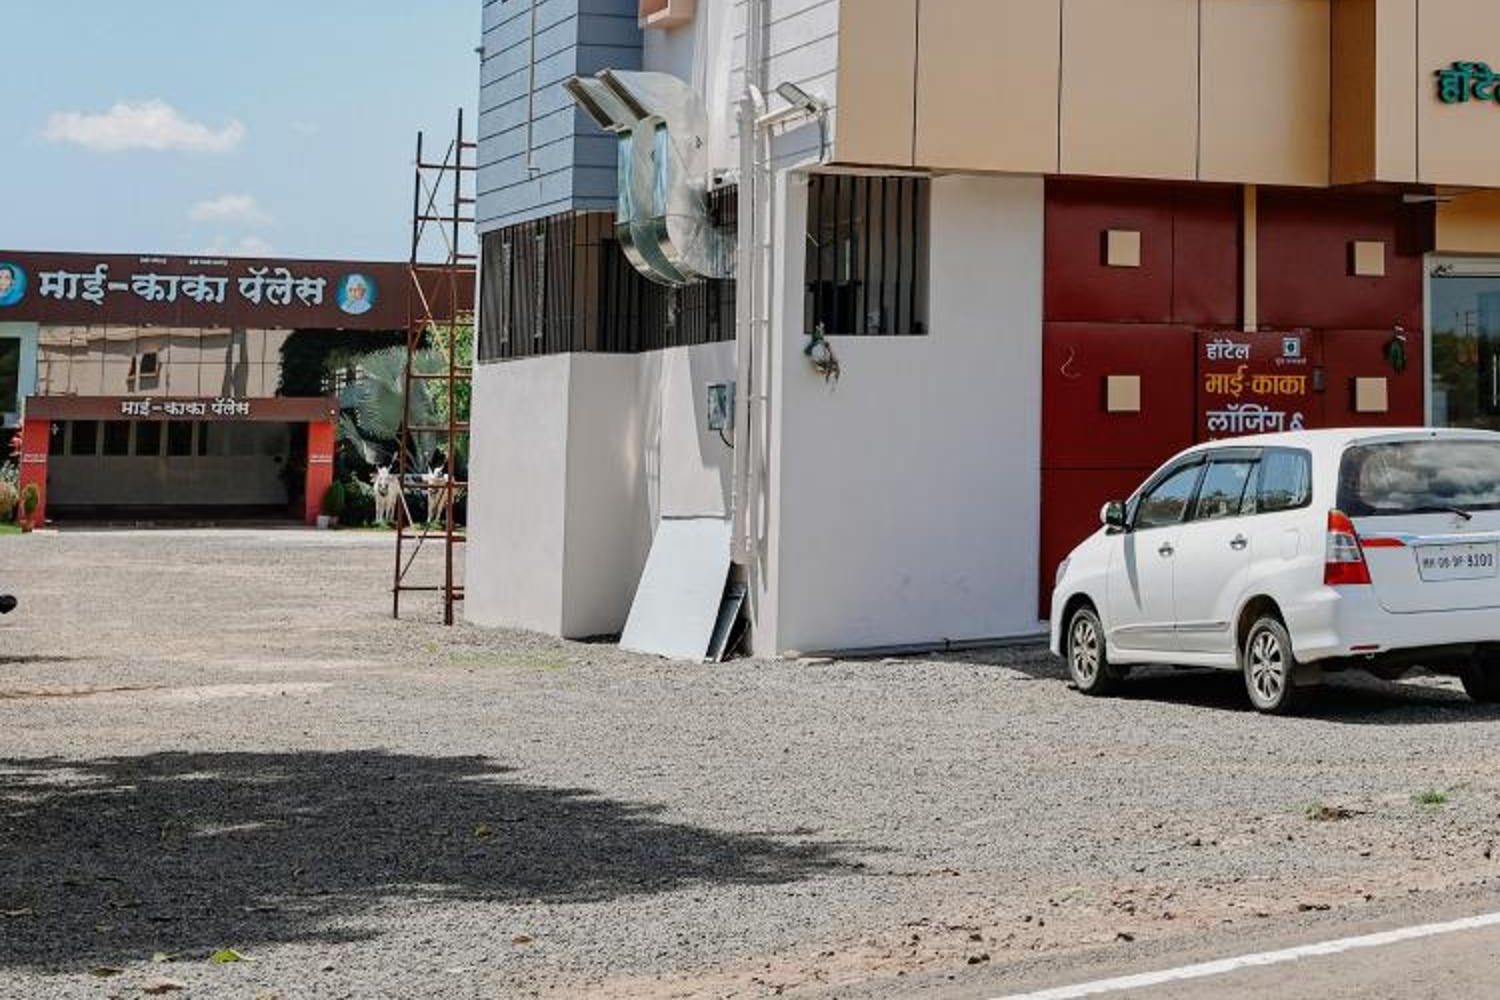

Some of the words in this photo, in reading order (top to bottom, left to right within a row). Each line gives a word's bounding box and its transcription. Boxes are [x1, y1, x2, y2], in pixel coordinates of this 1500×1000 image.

[238, 266, 327, 306] पॅलेस
[1205, 338, 1250, 359] हॉटेल
[211, 397, 250, 415] पॅलेस
[1206, 403, 1286, 432] लॉजिंग
